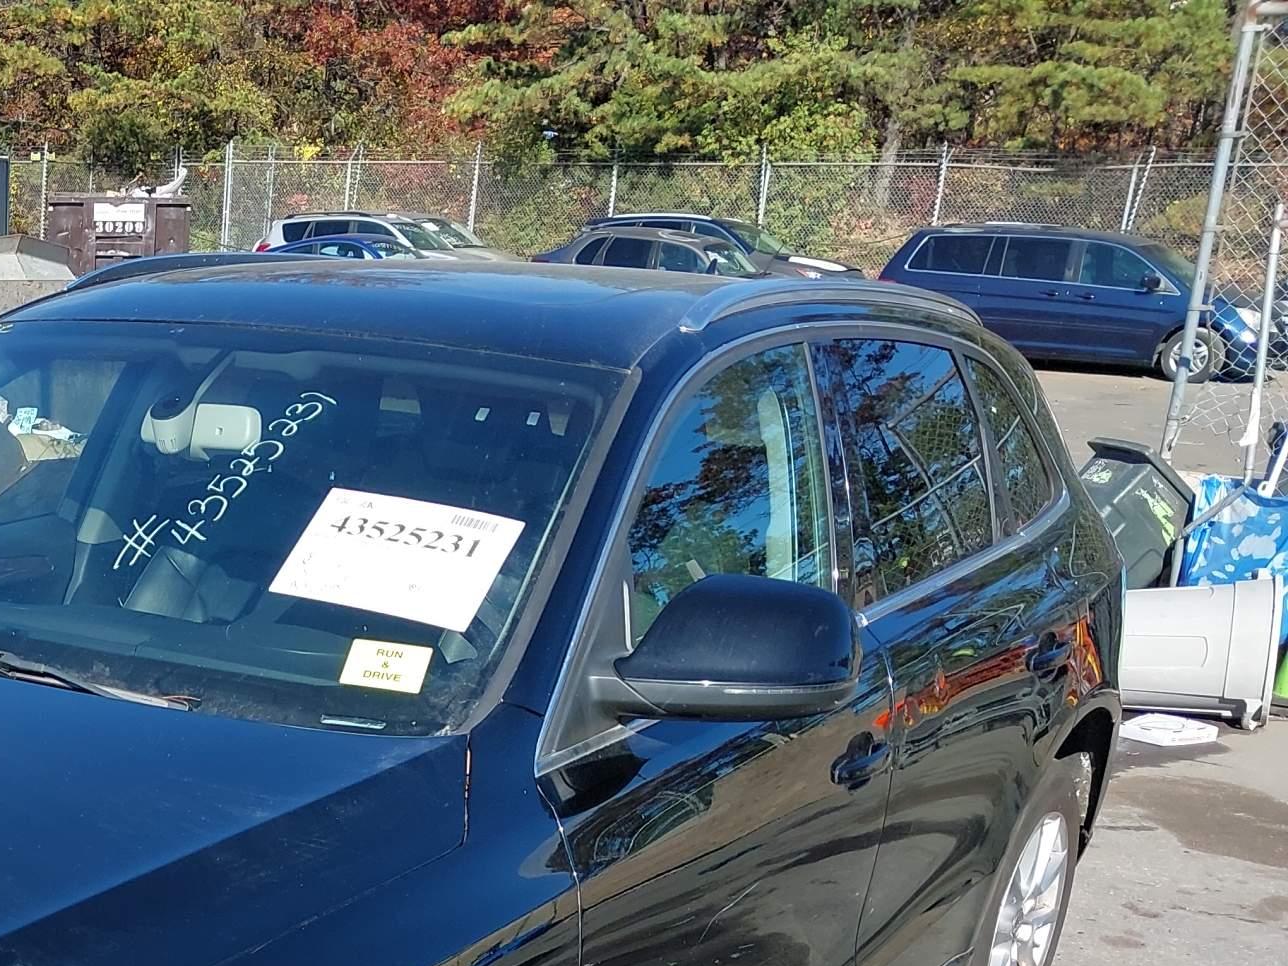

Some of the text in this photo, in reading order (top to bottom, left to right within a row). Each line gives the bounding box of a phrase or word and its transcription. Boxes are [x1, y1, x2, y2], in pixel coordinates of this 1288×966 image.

[171, 391, 337, 545] 43525231
[330, 515, 481, 558] 43525231
[376, 648, 404, 659] RUN
[381, 661, 389, 669] &
[363, 670, 401, 682] DRIVE
